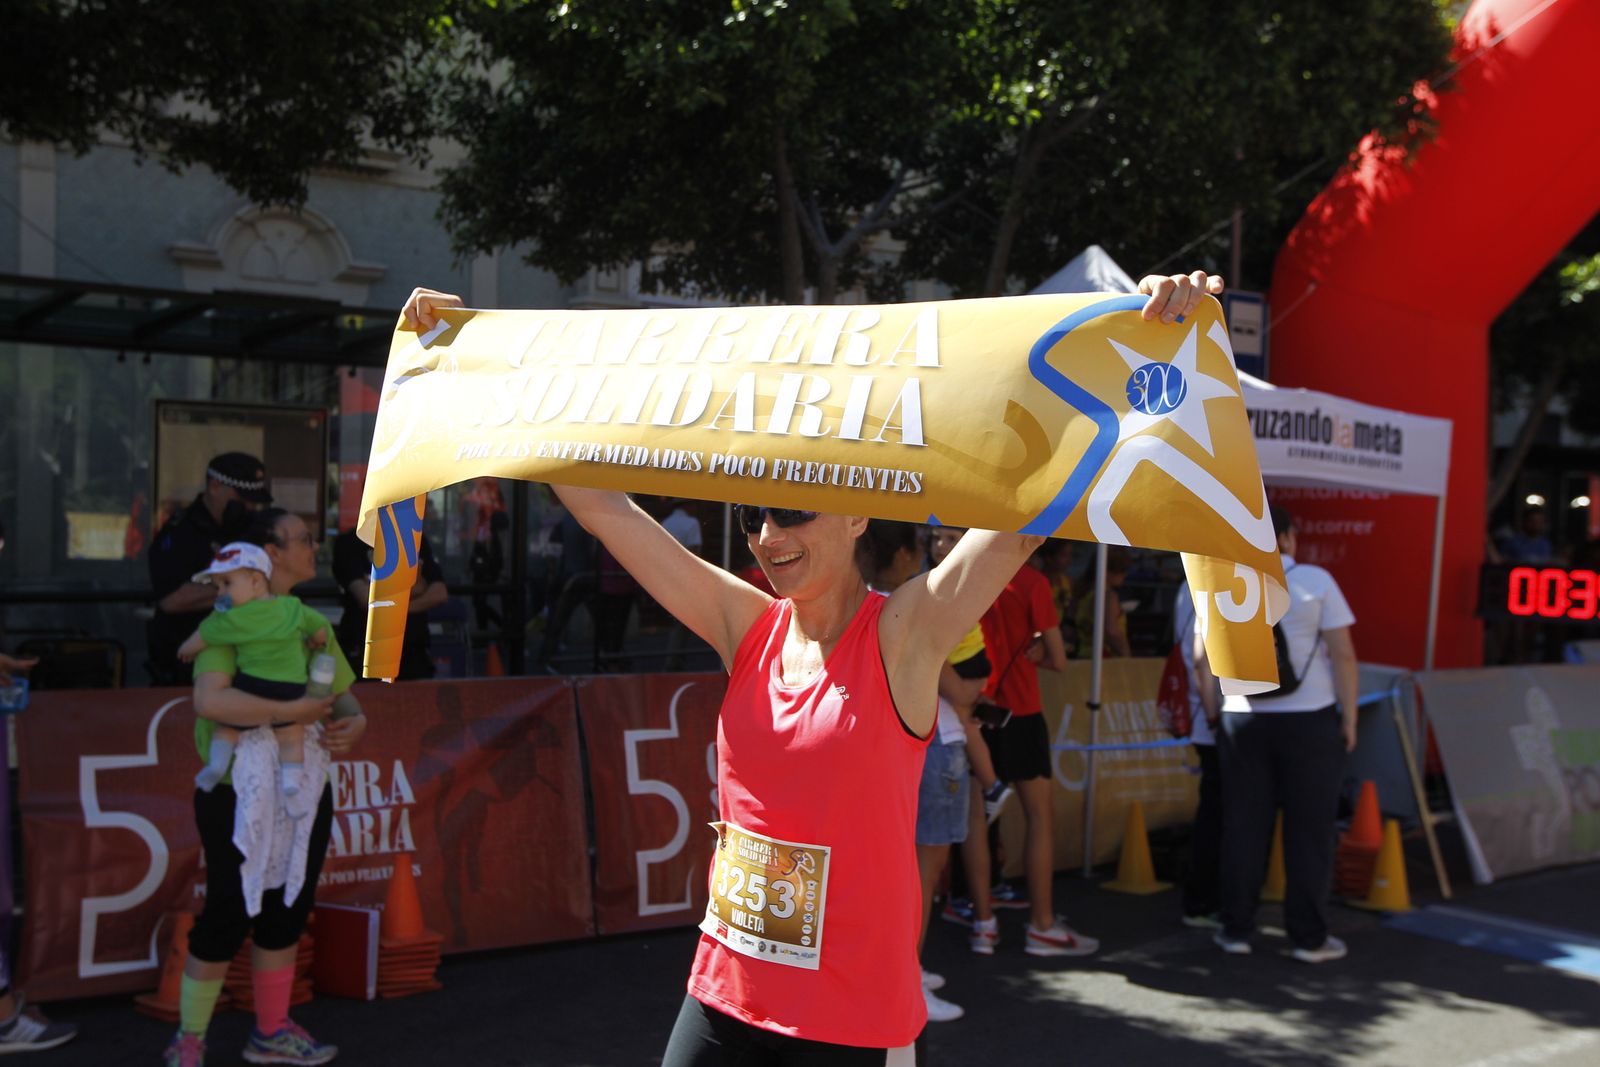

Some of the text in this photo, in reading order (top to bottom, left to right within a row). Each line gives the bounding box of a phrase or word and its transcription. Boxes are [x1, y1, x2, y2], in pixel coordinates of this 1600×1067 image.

[508, 303, 943, 367] CARRERA
[474, 369, 928, 447] SOLIDARIA
[1246, 408, 1403, 456] ruzandolameta
[455, 440, 923, 495] POR LAS ENFERMEDADES POCO FRECUENTES
[1508, 567, 1600, 619] 00:3
[329, 759, 416, 811] ERA
[326, 808, 416, 858] ARIA
[717, 859, 797, 920] 3253
[731, 906, 765, 934] VIOLETA
